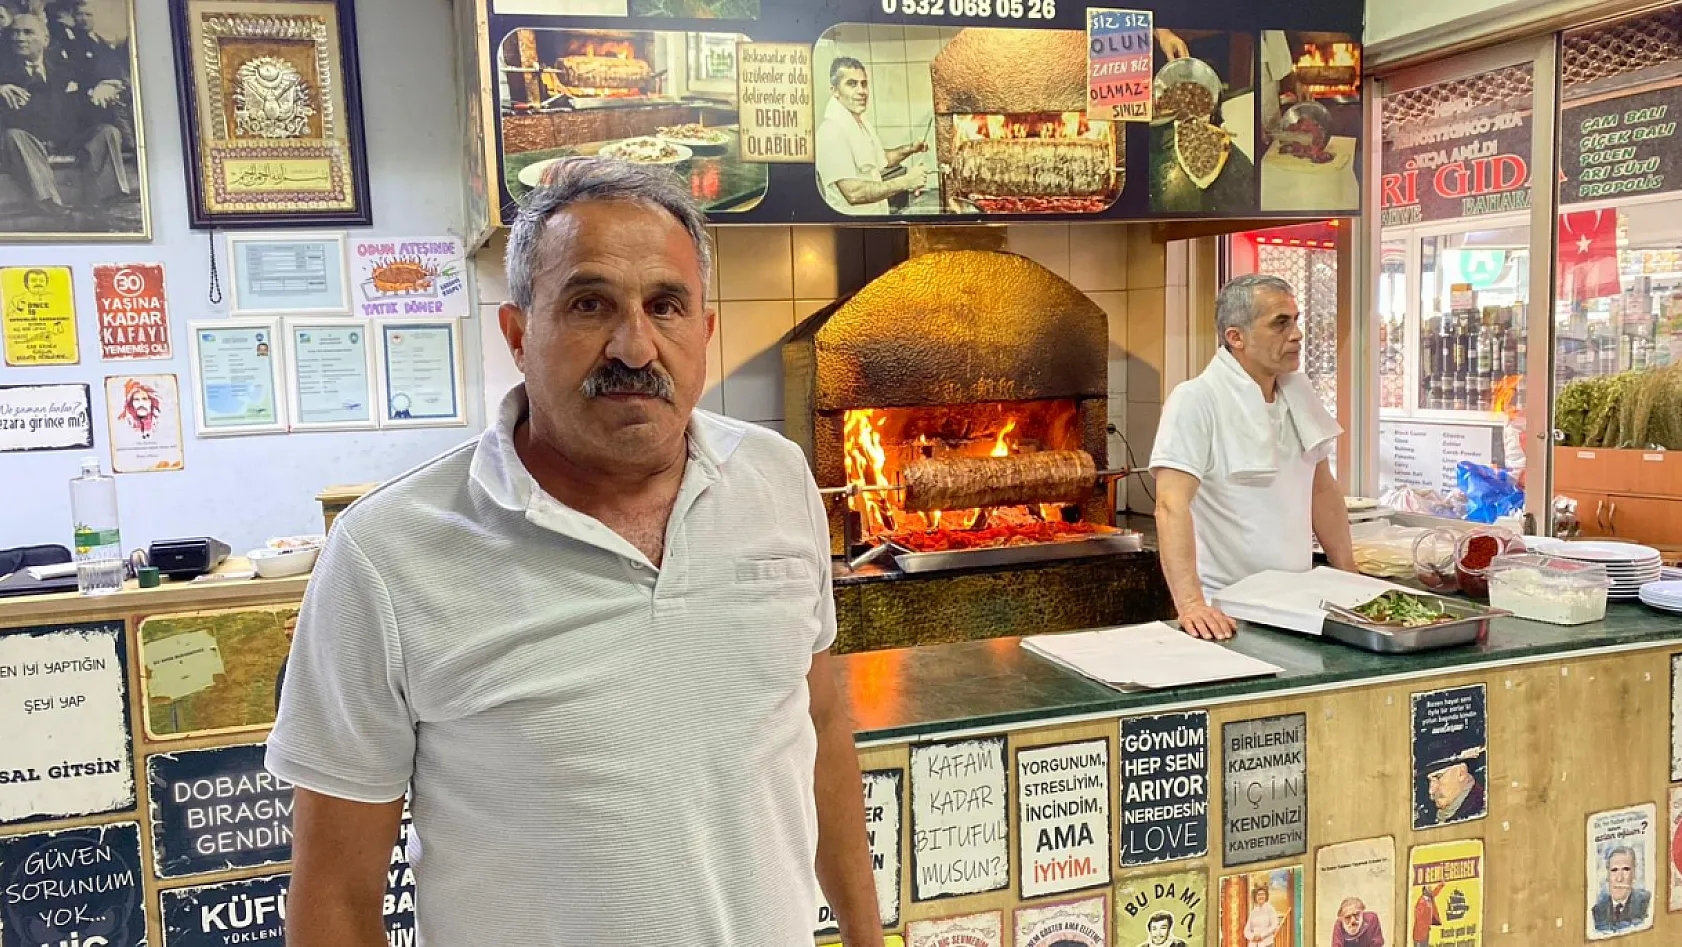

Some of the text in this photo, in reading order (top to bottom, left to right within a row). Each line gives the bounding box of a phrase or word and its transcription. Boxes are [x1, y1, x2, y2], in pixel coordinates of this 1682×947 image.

[901, 0, 945, 15] 532
[950, 0, 992, 17] 068
[996, 0, 1024, 18] 05
[1028, 0, 1056, 19] 26
[1091, 33, 1149, 54] OLUN
[788, 67, 808, 85] oldu
[1092, 61, 1128, 77] ZATEN
[755, 106, 798, 128] DEDİM
[1624, 105, 1667, 124] BALI
[1632, 122, 1676, 141] BALI
[1580, 146, 1636, 167] POLEN
[1580, 165, 1611, 181] ARI
[357, 243, 395, 258] ODUN
[118, 275, 141, 291] 30
[101, 296, 160, 312] YAŞINA
[103, 311, 162, 327] KADAR
[103, 326, 166, 343] KAFAYI
[29, 414, 64, 433] girince
[0, 665, 17, 678] EN
[44, 656, 106, 674] YAPTIĞIN
[59, 695, 86, 709] YAP
[1125, 726, 1204, 752] GÖYNÜM
[1231, 727, 1299, 751] BİRİLERİNİ
[0, 757, 120, 784] SAL GİTSİN
[928, 750, 993, 780] KAFAM
[1021, 753, 1106, 776] YORGUNUM,
[1125, 748, 1204, 777] HEP SENİ
[1229, 751, 1301, 773] KAZANMAK
[1024, 773, 1103, 797] STRESLİYİM,
[1125, 775, 1203, 803] ARIYOR
[930, 785, 993, 816] KADAR
[1025, 796, 1103, 822] İNCİNDİM,
[1125, 799, 1205, 825] NEREDESİN
[1230, 805, 1301, 833] KENDİNİZİ
[1036, 822, 1094, 853] AMA
[1130, 821, 1198, 854] LOVE
[1229, 829, 1302, 852] KAYBETMEYİN
[24, 846, 111, 875] GÜVEN
[922, 856, 1001, 885] MUSUN?
[1034, 855, 1097, 883] İYİYİM.
[6, 870, 135, 903] SORUNUM
[1124, 891, 1148, 917] BU
[1155, 883, 1175, 899] DA
